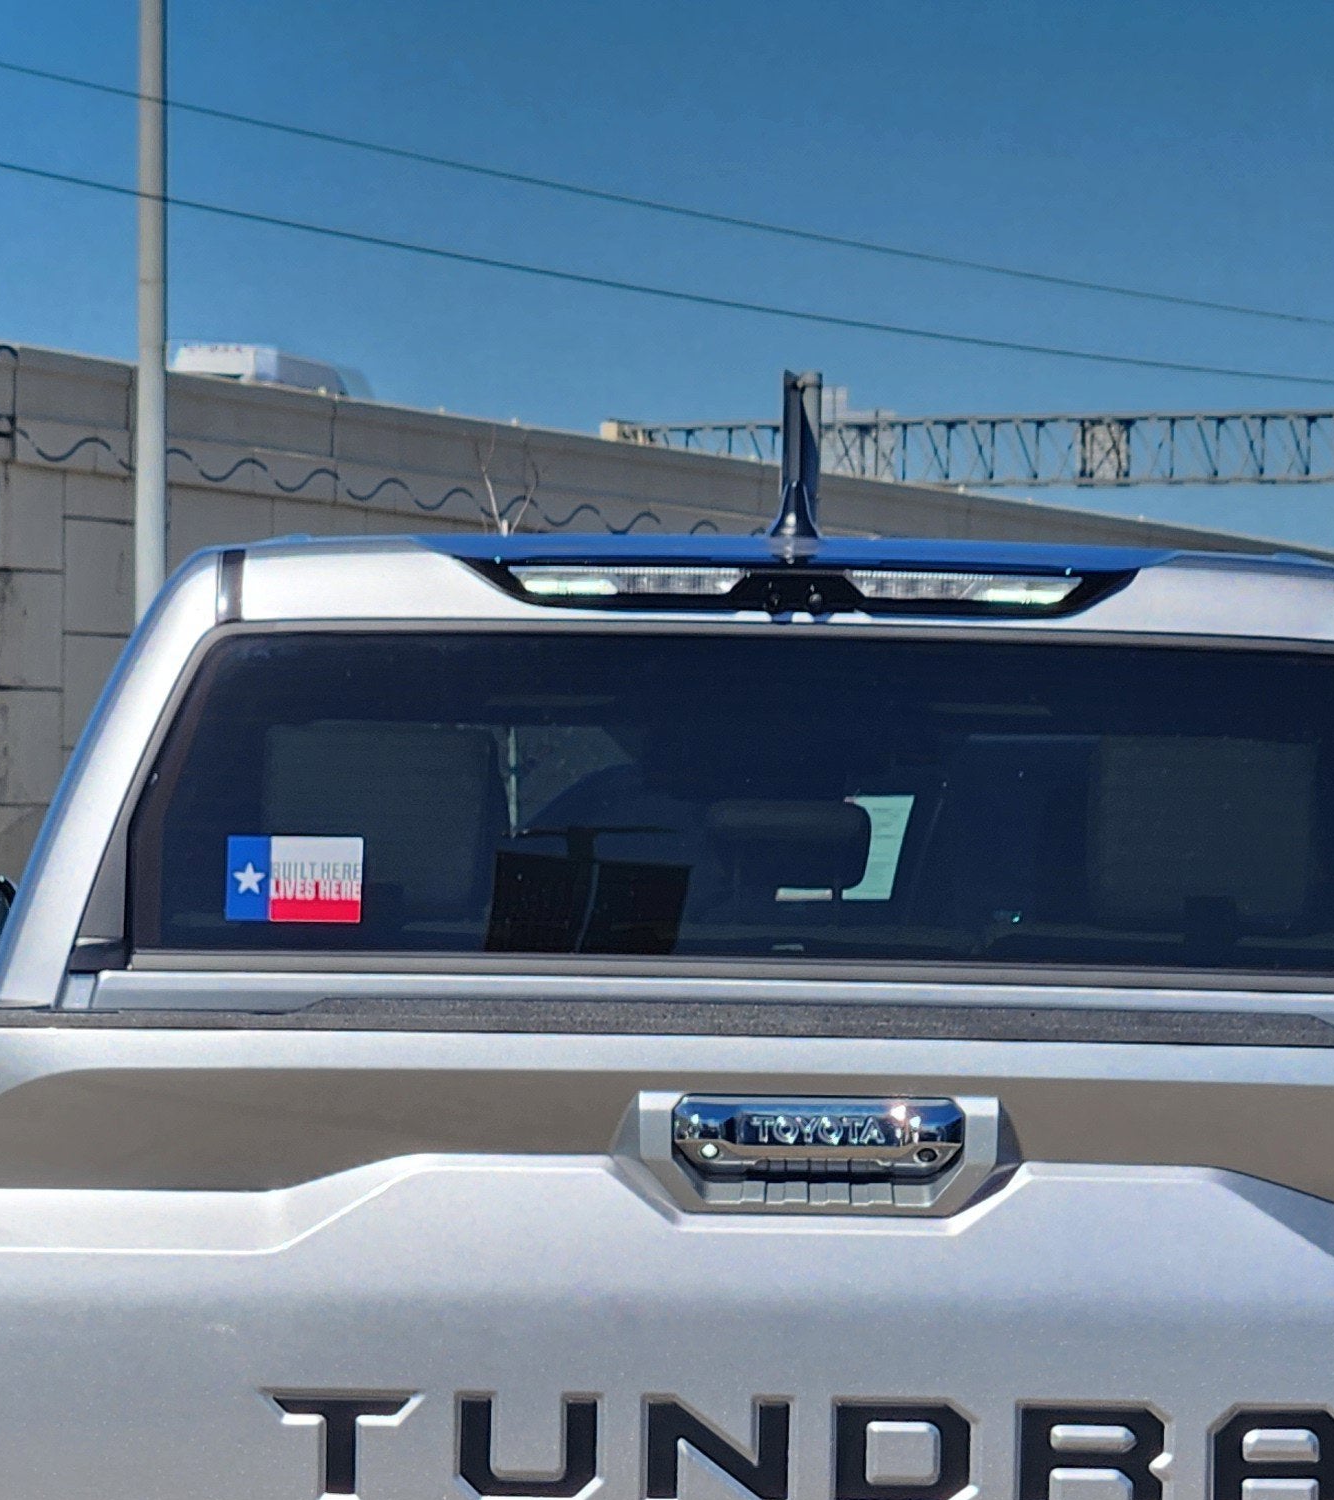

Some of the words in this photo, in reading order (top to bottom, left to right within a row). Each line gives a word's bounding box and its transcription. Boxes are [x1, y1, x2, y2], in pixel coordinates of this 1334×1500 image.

[271, 862, 316, 880] BUILT
[321, 862, 362, 881] HERE
[272, 880, 316, 900] LIVES
[319, 880, 361, 901] HERE
[750, 1114, 885, 1145] TOYOTA
